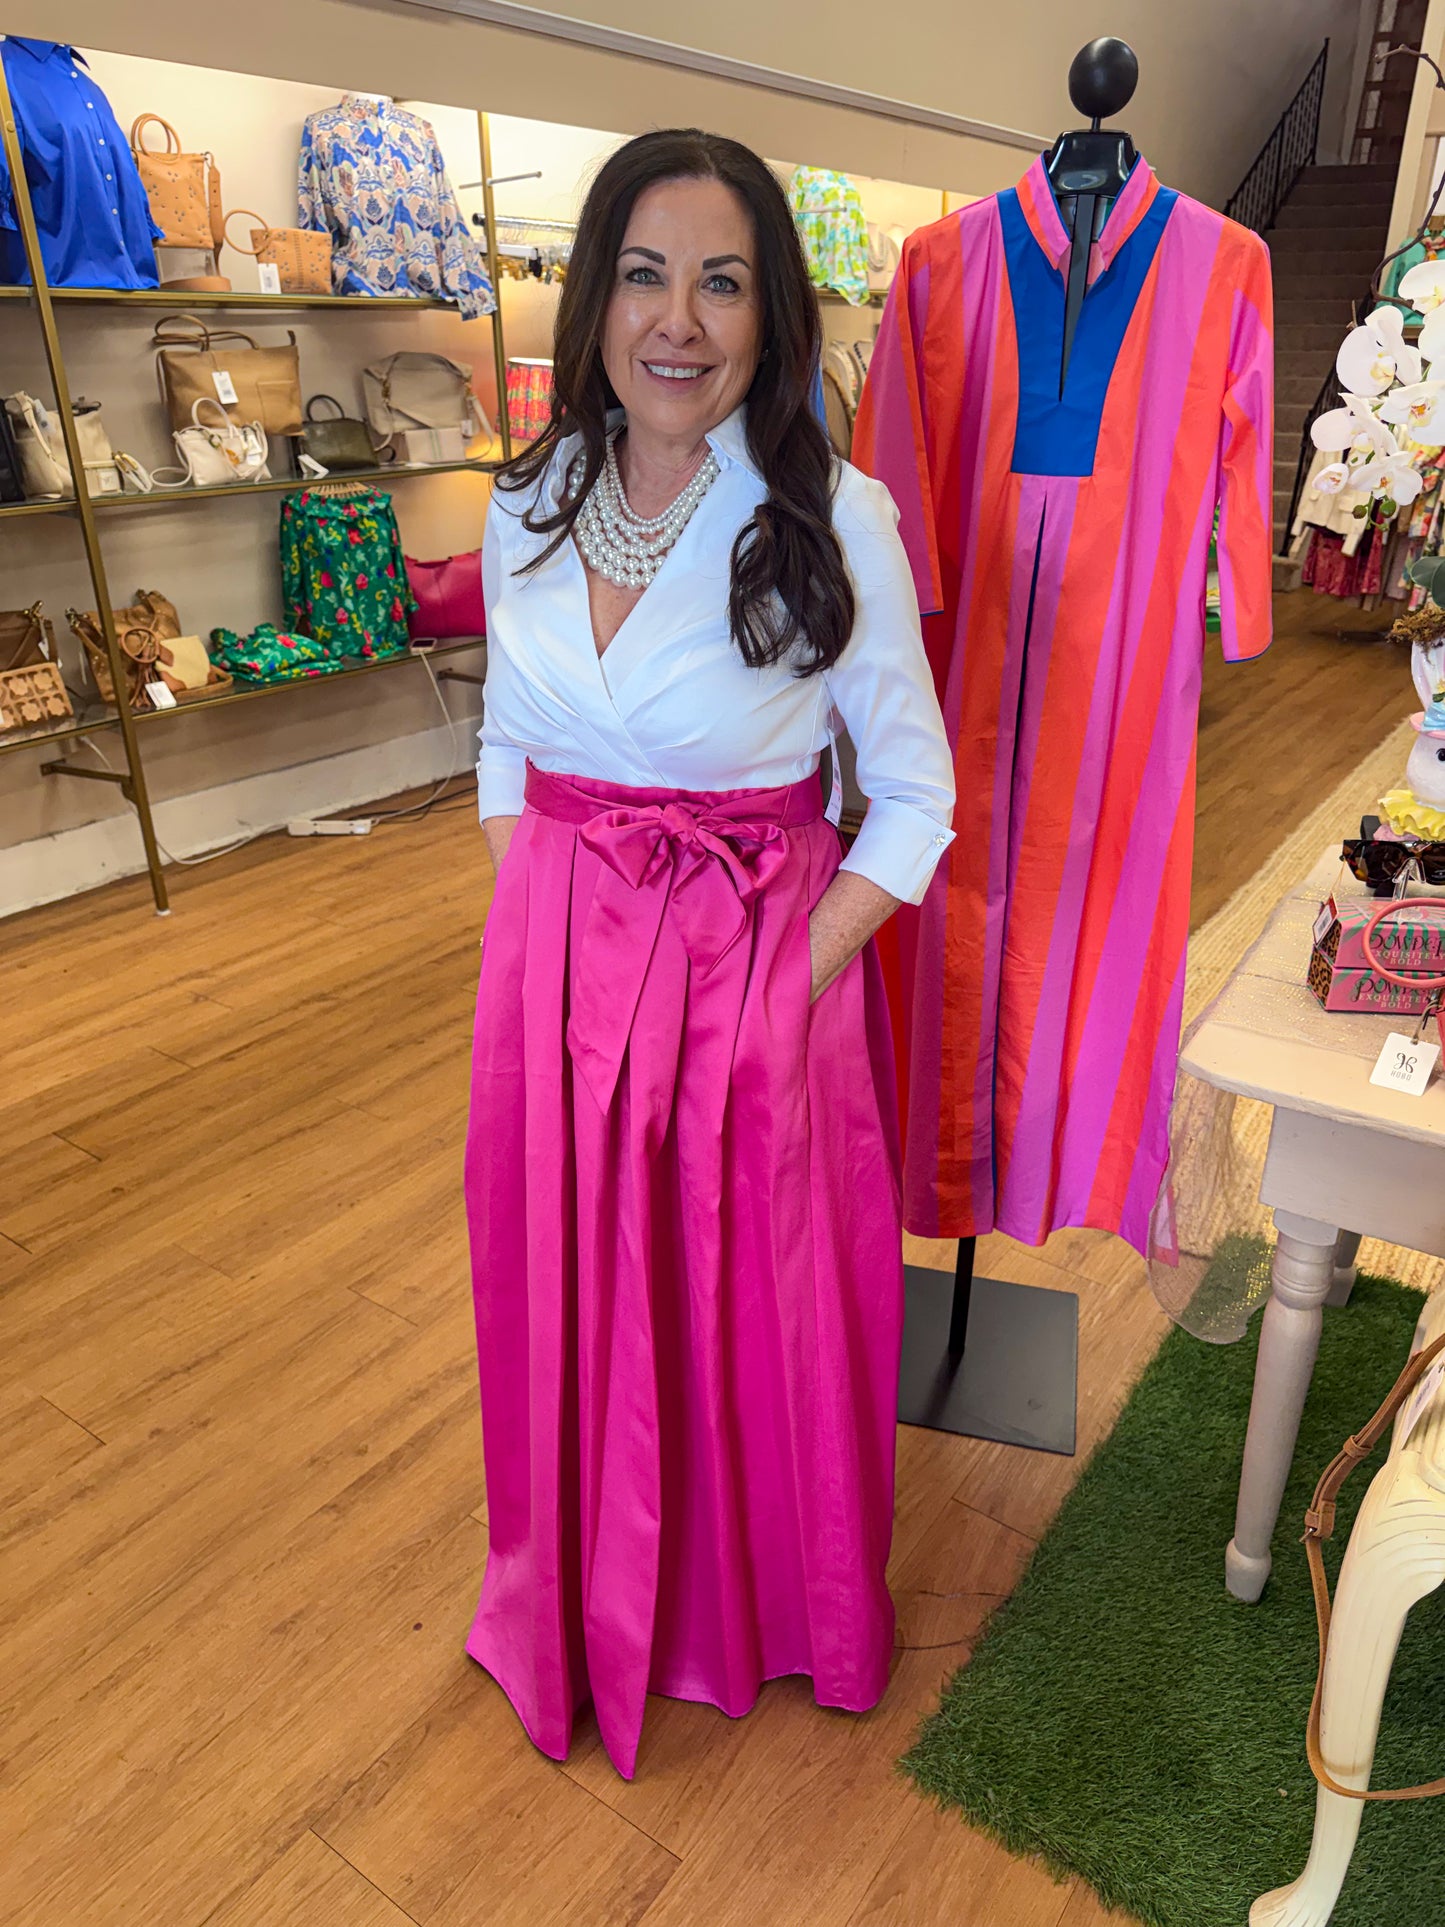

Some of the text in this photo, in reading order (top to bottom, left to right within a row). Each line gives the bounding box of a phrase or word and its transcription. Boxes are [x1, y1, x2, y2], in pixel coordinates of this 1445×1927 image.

[1371, 950, 1445, 960] XQUISITELY
[1390, 958, 1421, 966] BOLD
[1381, 1001, 1411, 1009] BOLD
